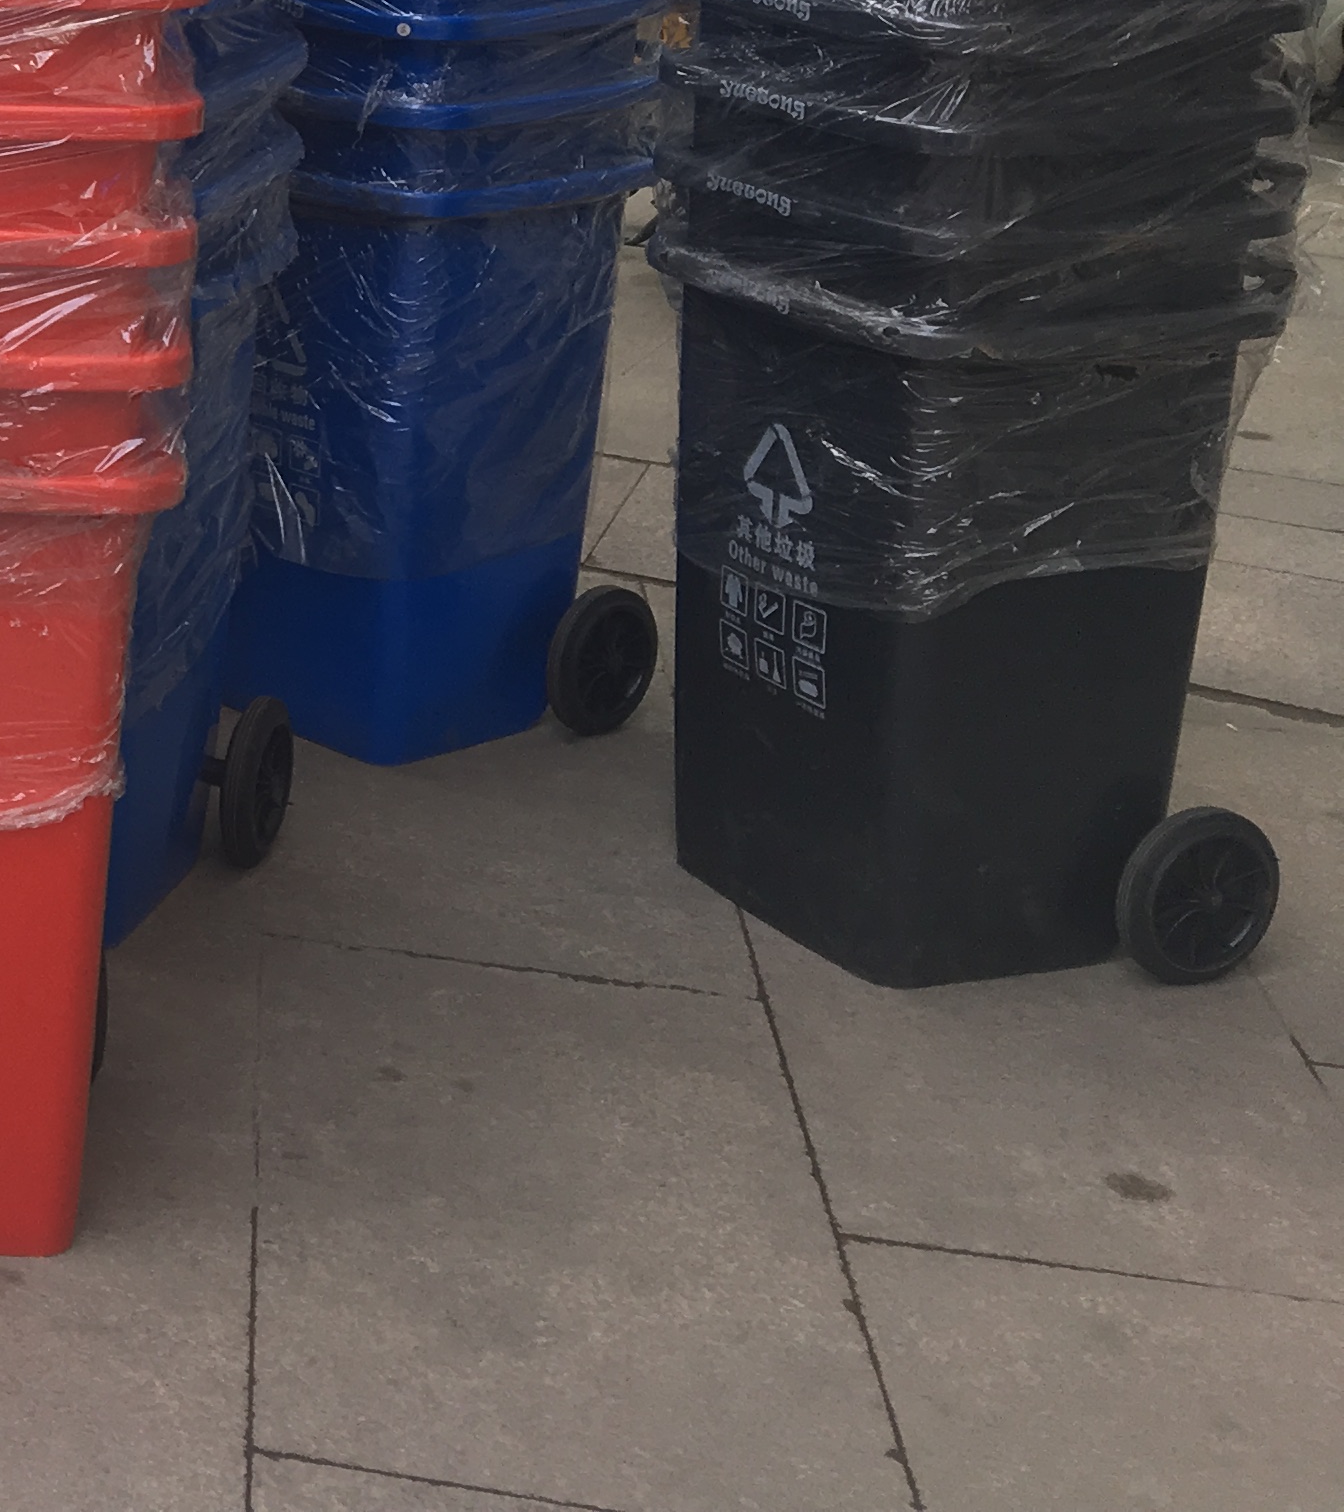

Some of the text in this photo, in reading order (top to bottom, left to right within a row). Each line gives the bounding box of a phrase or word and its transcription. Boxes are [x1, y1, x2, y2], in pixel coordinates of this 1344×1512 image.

[719, 79, 806, 120] yuetong
[706, 171, 793, 217] yuetong
[728, 539, 819, 598] Other waste
[737, 514, 816, 572] 其他垃圾
